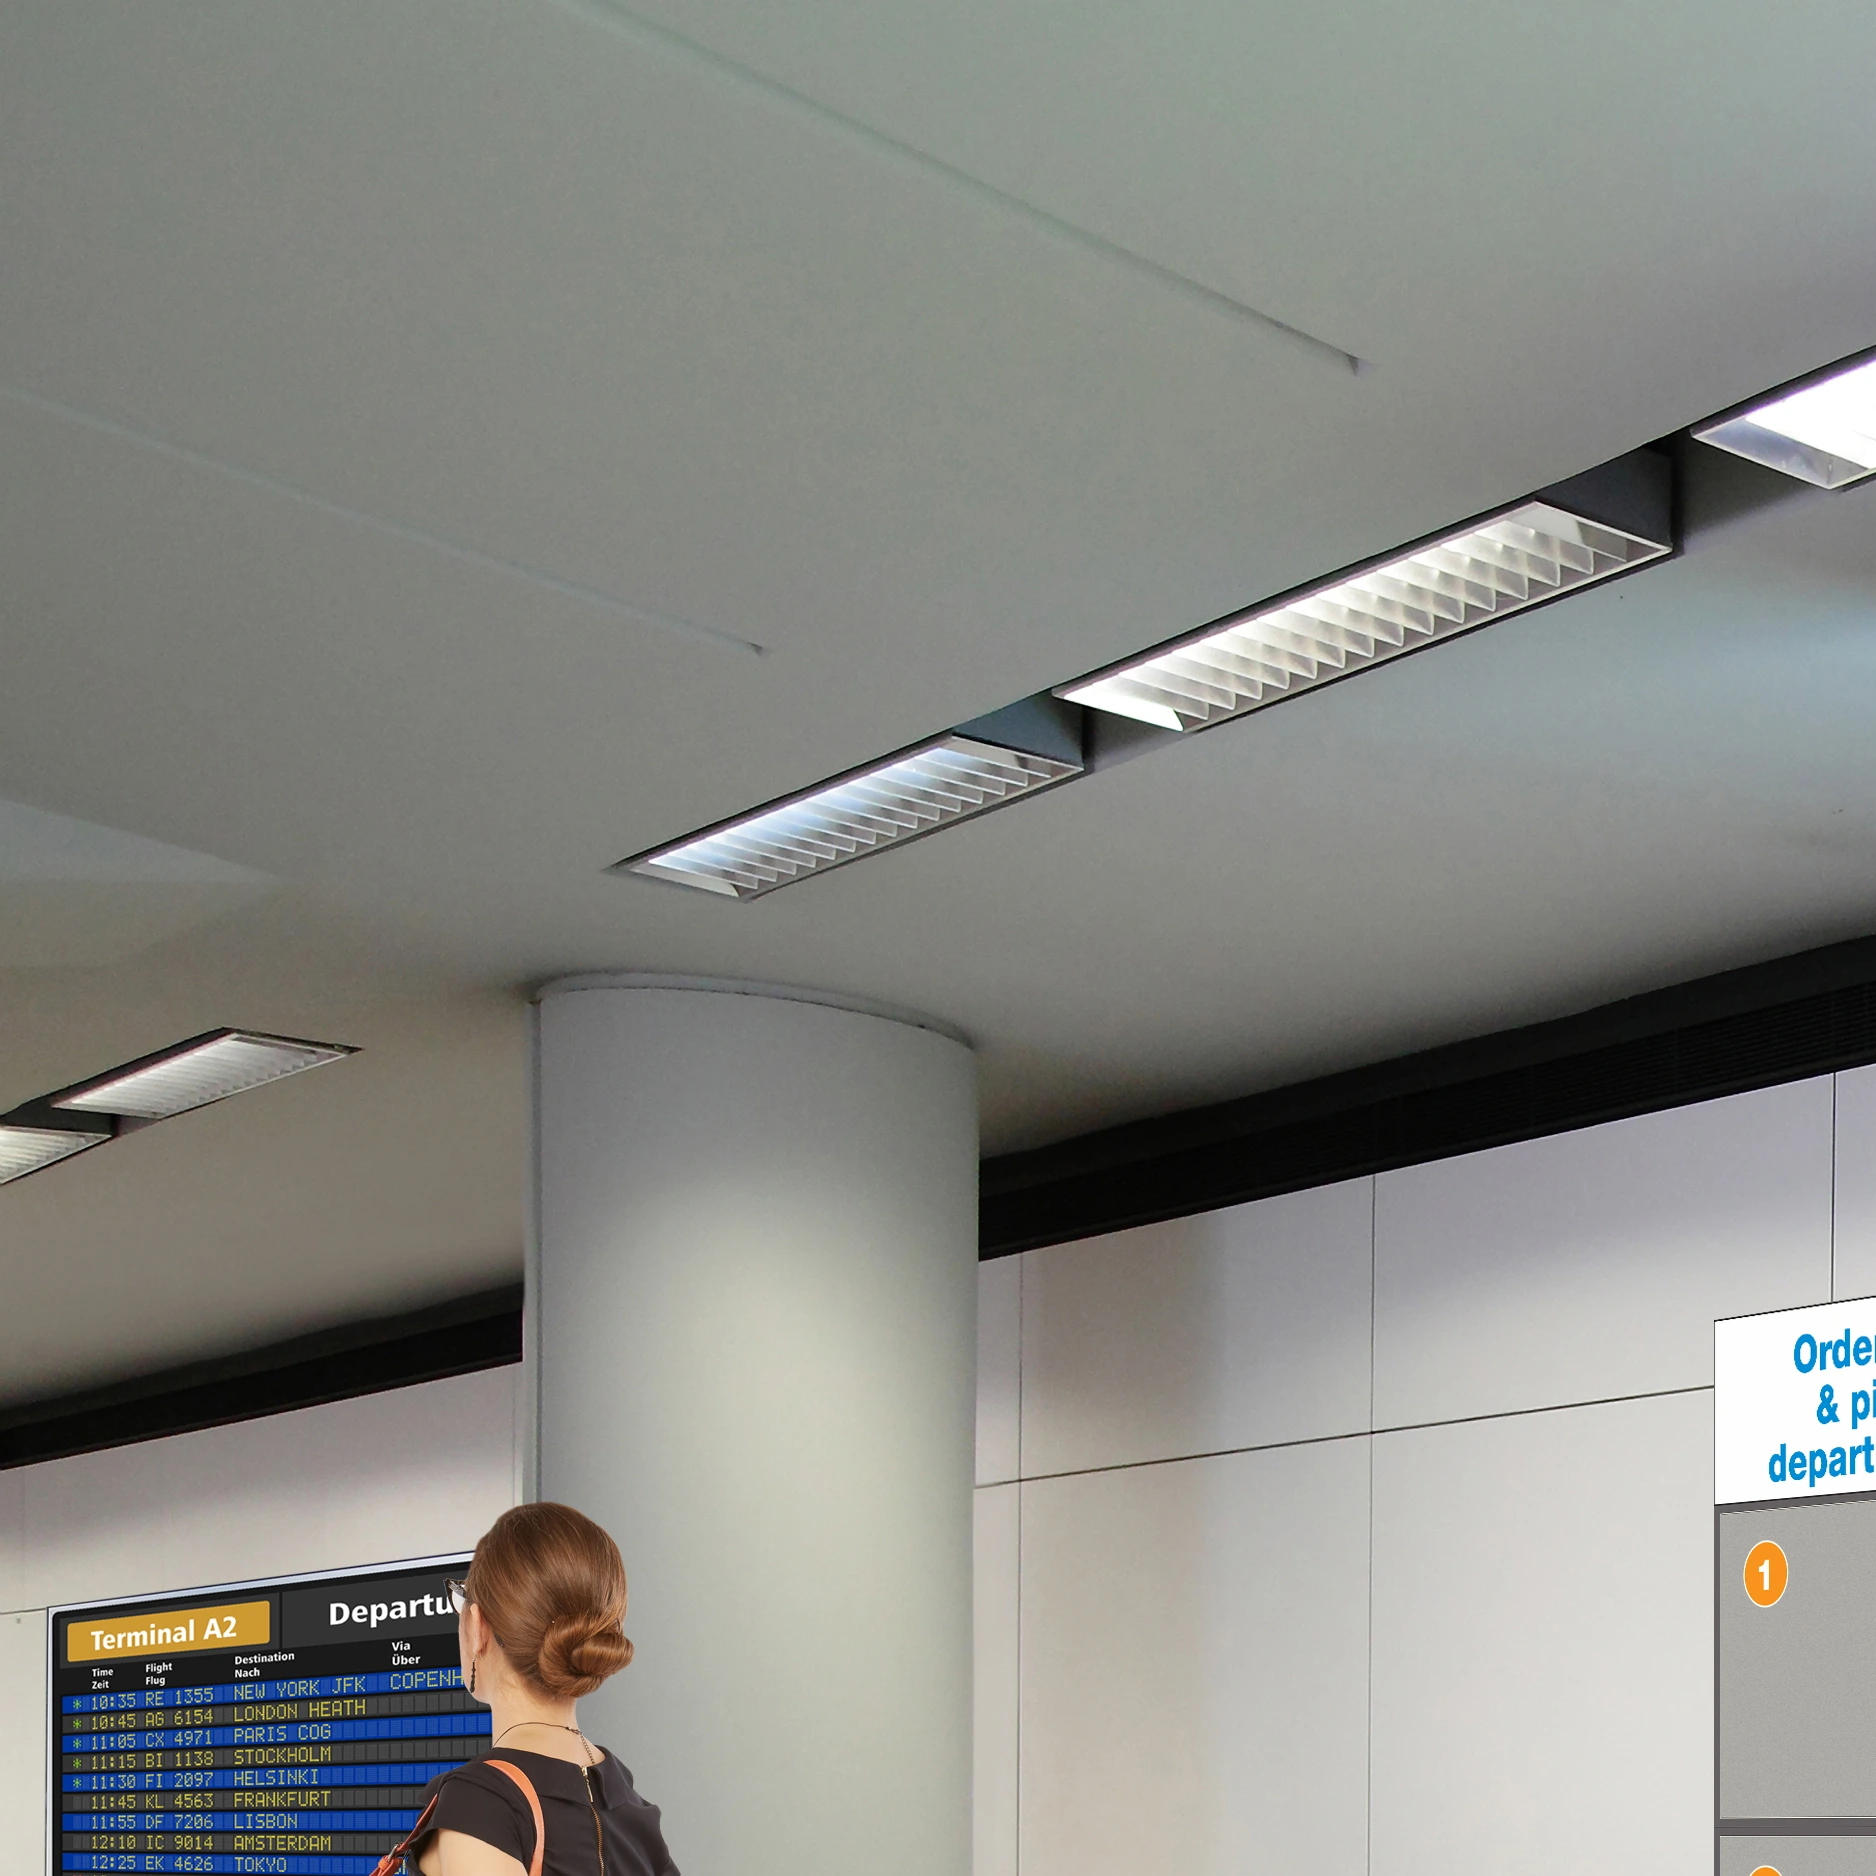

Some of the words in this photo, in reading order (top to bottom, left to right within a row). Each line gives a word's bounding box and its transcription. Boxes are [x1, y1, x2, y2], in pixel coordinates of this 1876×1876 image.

[1817, 1384, 1840, 1424] &
[1759, 1560, 1769, 1590] 1
[329, 1593, 454, 1629] Departu
[91, 1619, 194, 1650] Terminal
[204, 1616, 236, 1639] A2
[91, 1667, 114, 1677] Time
[145, 1662, 173, 1674] Flight
[234, 1651, 295, 1665] Destination
[391, 1640, 411, 1652] Via
[91, 1679, 110, 1690] Zeit
[145, 1675, 166, 1687] Flug
[234, 1667, 260, 1678] Nach
[392, 1653, 421, 1666] Über
[92, 1693, 136, 1710] 10:35
[145, 1691, 164, 1706] RE
[176, 1687, 213, 1705] 1355
[234, 1683, 265, 1701] NEW
[276, 1679, 320, 1697] YORK
[332, 1676, 366, 1694] JFK
[390, 1670, 464, 1690] COPENH
[92, 1713, 136, 1730] 10:45
[145, 1711, 164, 1727] AG
[174, 1708, 214, 1725] 6154
[234, 1703, 298, 1722] LONDON
[309, 1698, 366, 1718] HEATH
[92, 1733, 136, 1750] 11:05
[145, 1732, 164, 1747] CX
[174, 1730, 212, 1746] 4971
[234, 1725, 287, 1743] PARIS
[298, 1723, 331, 1740] COG
[92, 1753, 136, 1770] 11:15
[145, 1752, 163, 1768] BI
[175, 1750, 214, 1767] 1138
[234, 1745, 331, 1765] STOCKHOLM
[92, 1774, 136, 1790] 11:30
[145, 1773, 162, 1788] FI
[174, 1772, 213, 1788] 2097
[234, 1768, 318, 1786] HELSINKI
[92, 1794, 136, 1810] 11:45
[145, 1794, 164, 1809] KL
[174, 1793, 214, 1809] 4563
[234, 1790, 331, 1808] FRANKFURT
[92, 1814, 136, 1829] 11:55
[145, 1814, 164, 1829] DF
[174, 1814, 213, 1829] 7206
[234, 1813, 298, 1829] LISBON
